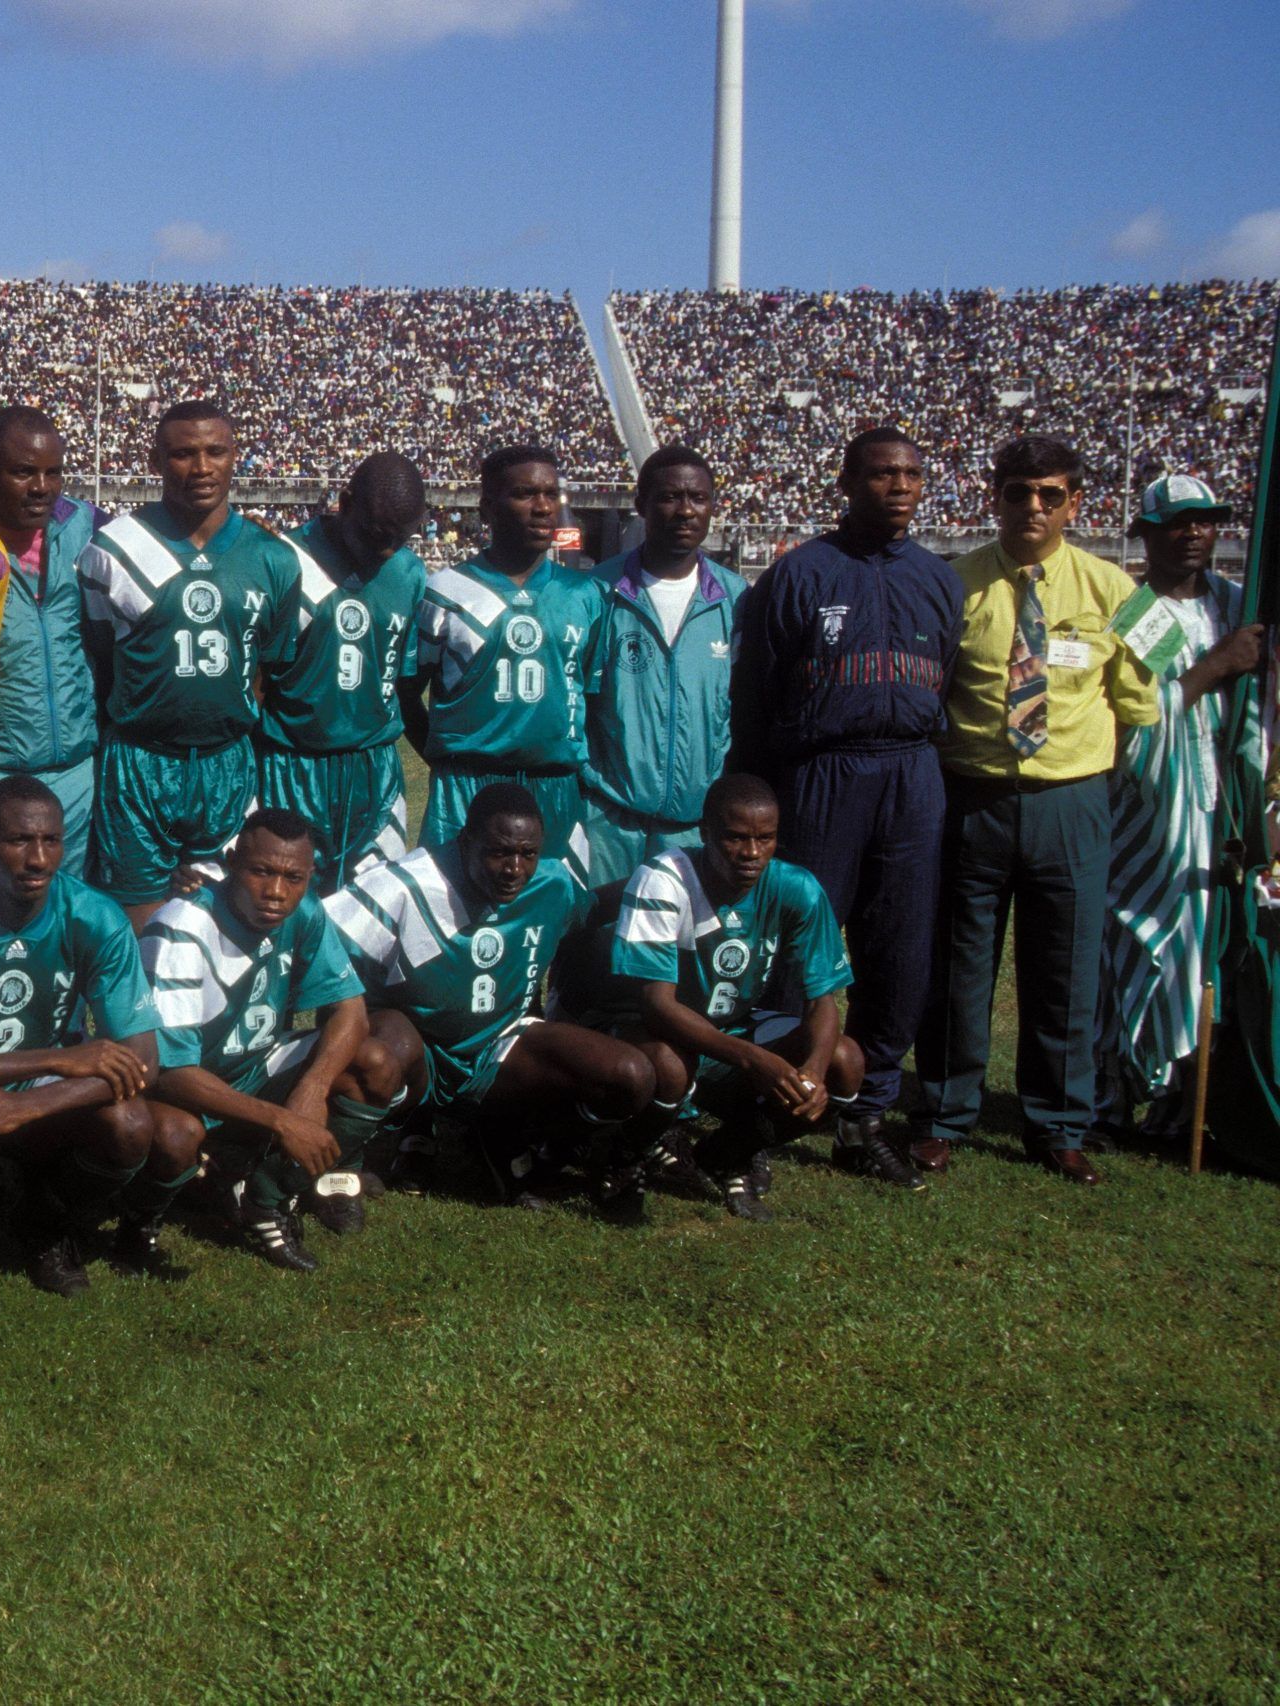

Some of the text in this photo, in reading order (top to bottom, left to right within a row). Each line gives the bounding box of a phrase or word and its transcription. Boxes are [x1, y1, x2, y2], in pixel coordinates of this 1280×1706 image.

[174, 630, 229, 677] 13
[338, 643, 363, 691] 9
[382, 612, 407, 720] NIGER
[494, 658, 545, 703] 10
[564, 624, 584, 740] NIGERIA
[471, 974, 496, 1013] 8
[519, 925, 544, 1018] NIGER
[707, 982, 739, 1018] 6
[223, 1004, 277, 1055] 12
